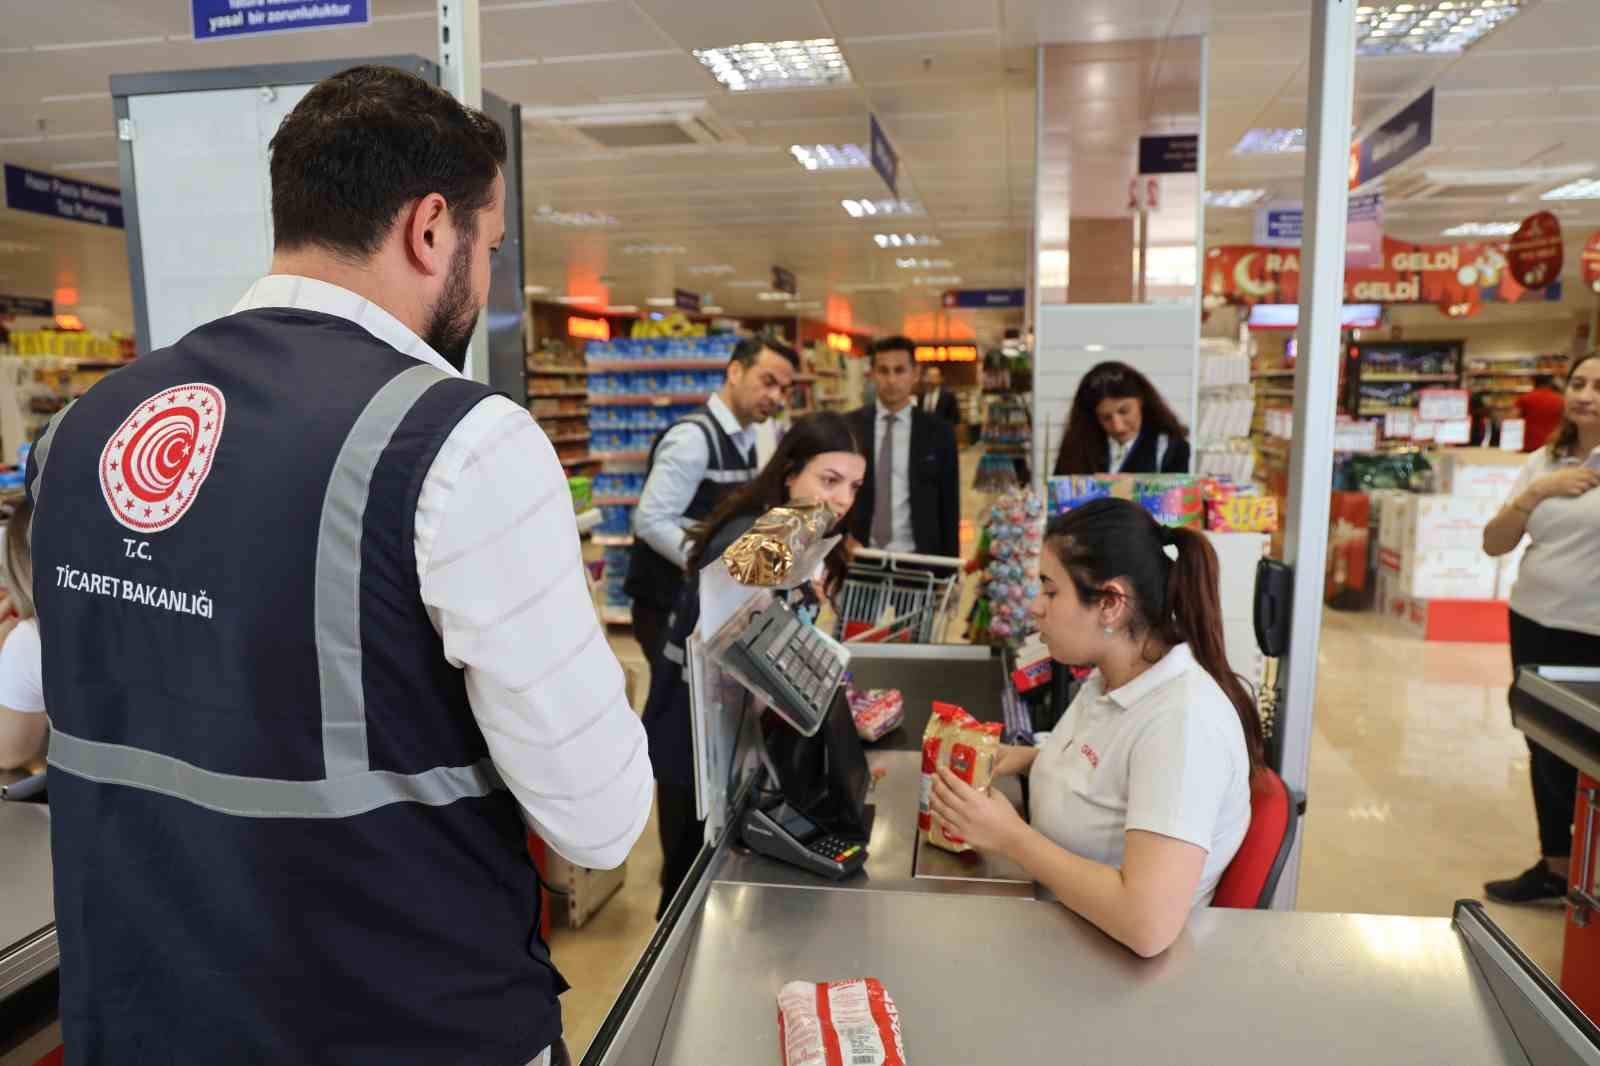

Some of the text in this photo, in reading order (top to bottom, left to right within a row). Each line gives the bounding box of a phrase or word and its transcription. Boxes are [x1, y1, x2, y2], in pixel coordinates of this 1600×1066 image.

[209, 11, 243, 33] yasal
[248, 10, 265, 25] bir
[1392, 247, 1460, 271] GELDİ
[1353, 273, 1420, 301] GELDİ
[122, 538, 152, 561] T.C.
[56, 564, 213, 619] TİCARET BAKANLIĞI
